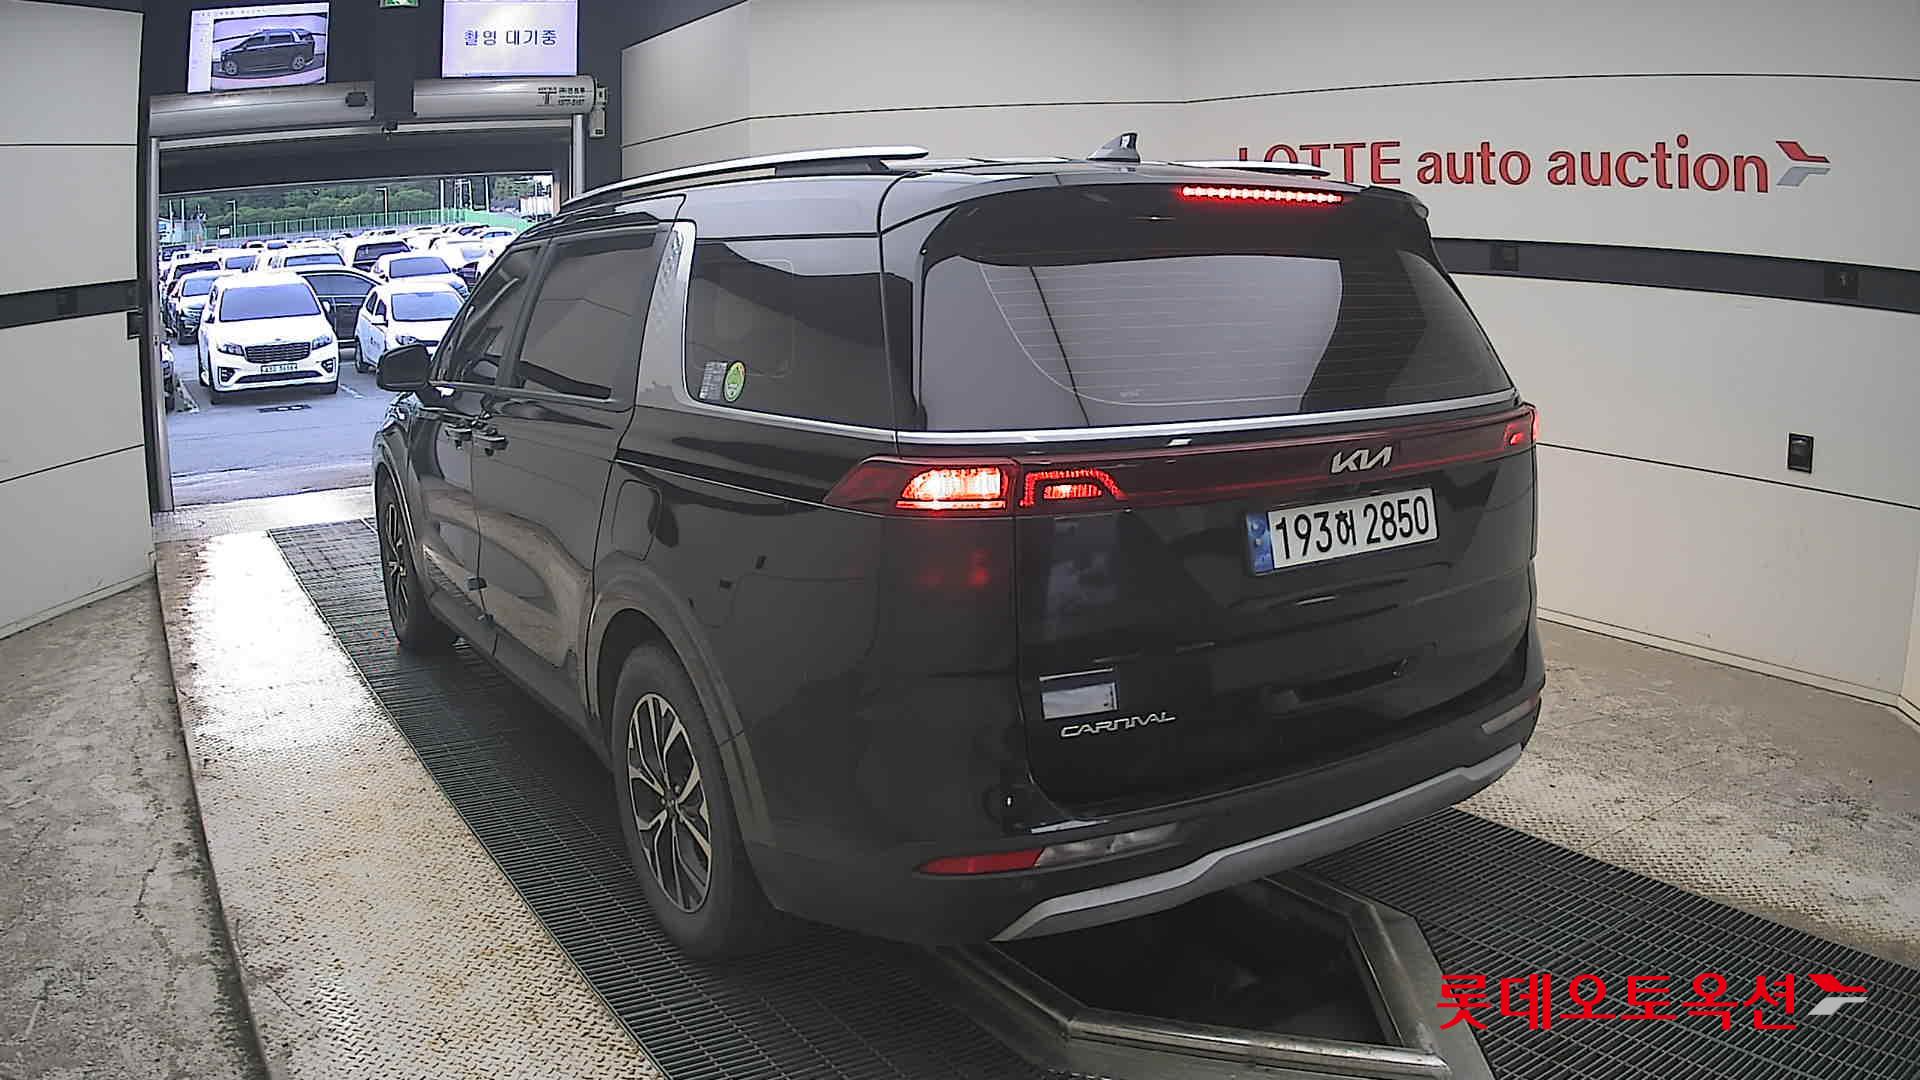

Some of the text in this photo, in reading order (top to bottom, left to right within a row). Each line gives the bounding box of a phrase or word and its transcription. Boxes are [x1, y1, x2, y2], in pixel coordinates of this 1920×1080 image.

[505, 29, 558, 46] 대기중
[1416, 141, 1531, 185] auto
[1547, 134, 1769, 193] auction
[1331, 447, 1392, 473] KIA
[1276, 496, 1430, 559] 193허 2850
[1061, 711, 1176, 738] CARNIVAL
